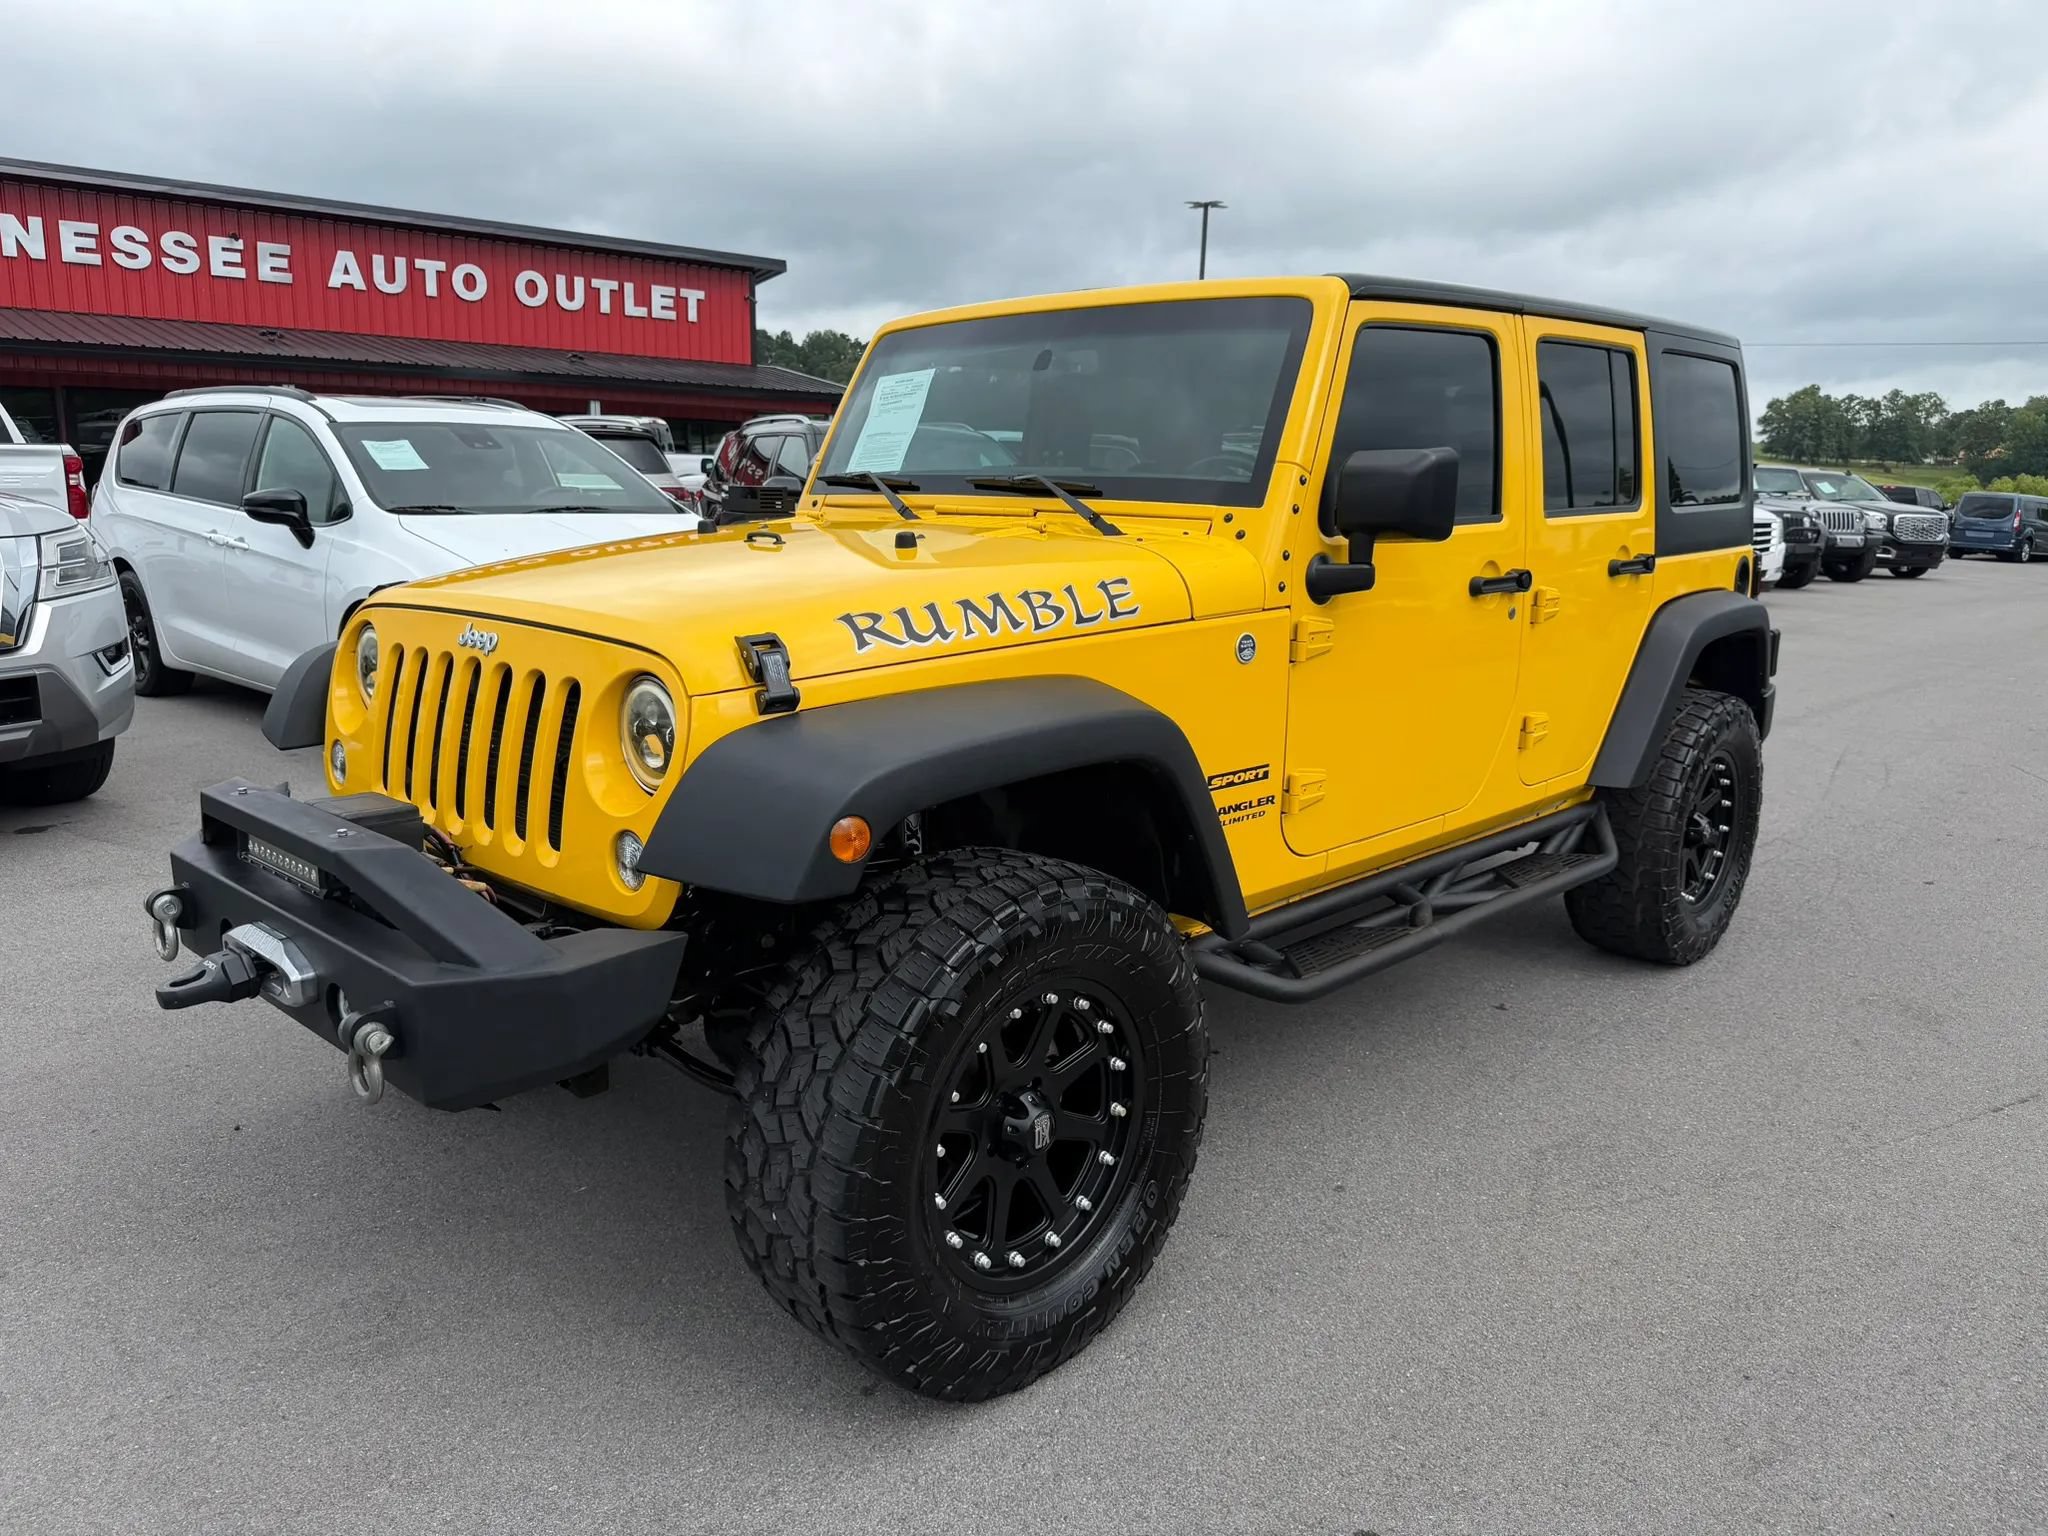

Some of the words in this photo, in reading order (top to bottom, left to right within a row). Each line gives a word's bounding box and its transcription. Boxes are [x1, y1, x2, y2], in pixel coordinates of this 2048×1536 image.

[0, 213, 293, 284] NESSEE
[327, 250, 488, 301] AUTO
[514, 270, 705, 322] OUTLET
[834, 577, 1142, 654] RUMBLE
[458, 622, 498, 656] Jeep
[1208, 766, 1270, 790] SPORT
[1220, 810, 1265, 826] LIMITED
